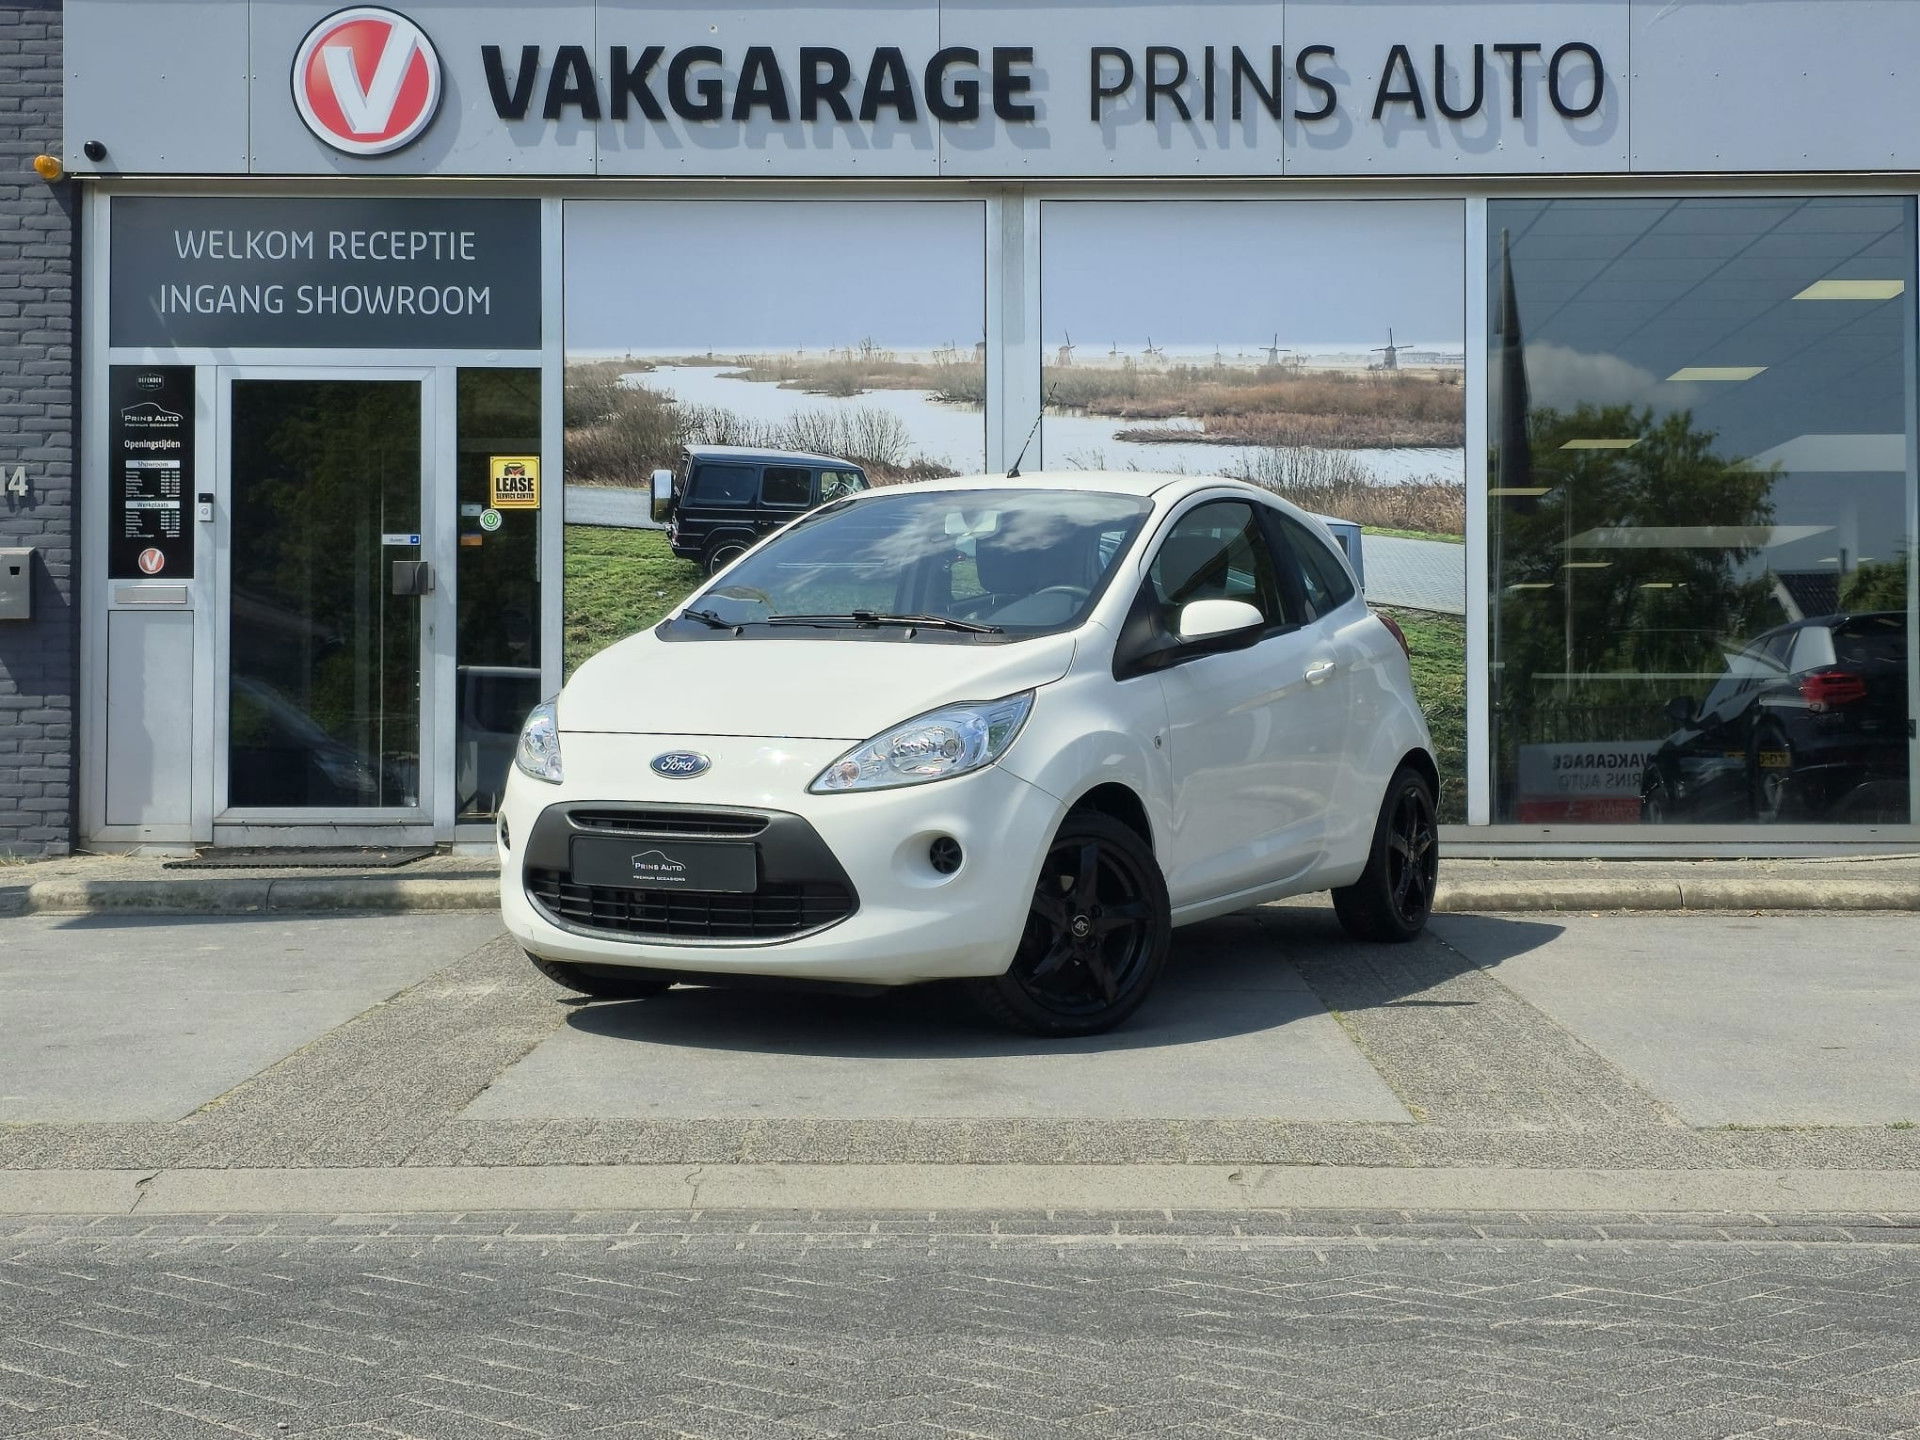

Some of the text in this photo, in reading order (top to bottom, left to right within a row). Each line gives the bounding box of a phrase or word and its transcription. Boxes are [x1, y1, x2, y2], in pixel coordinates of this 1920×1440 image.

[480, 41, 1605, 121] VAKGARAGE PRINS AUTO
[174, 229, 476, 260] WELKOM RECEPTIE
[160, 284, 491, 315] INGANG SHOWROOM
[124, 439, 181, 450] Openingstijden
[496, 478, 534, 491] LEASE
[661, 754, 696, 771] Ford
[635, 862, 683, 872] PRINS AUTO
